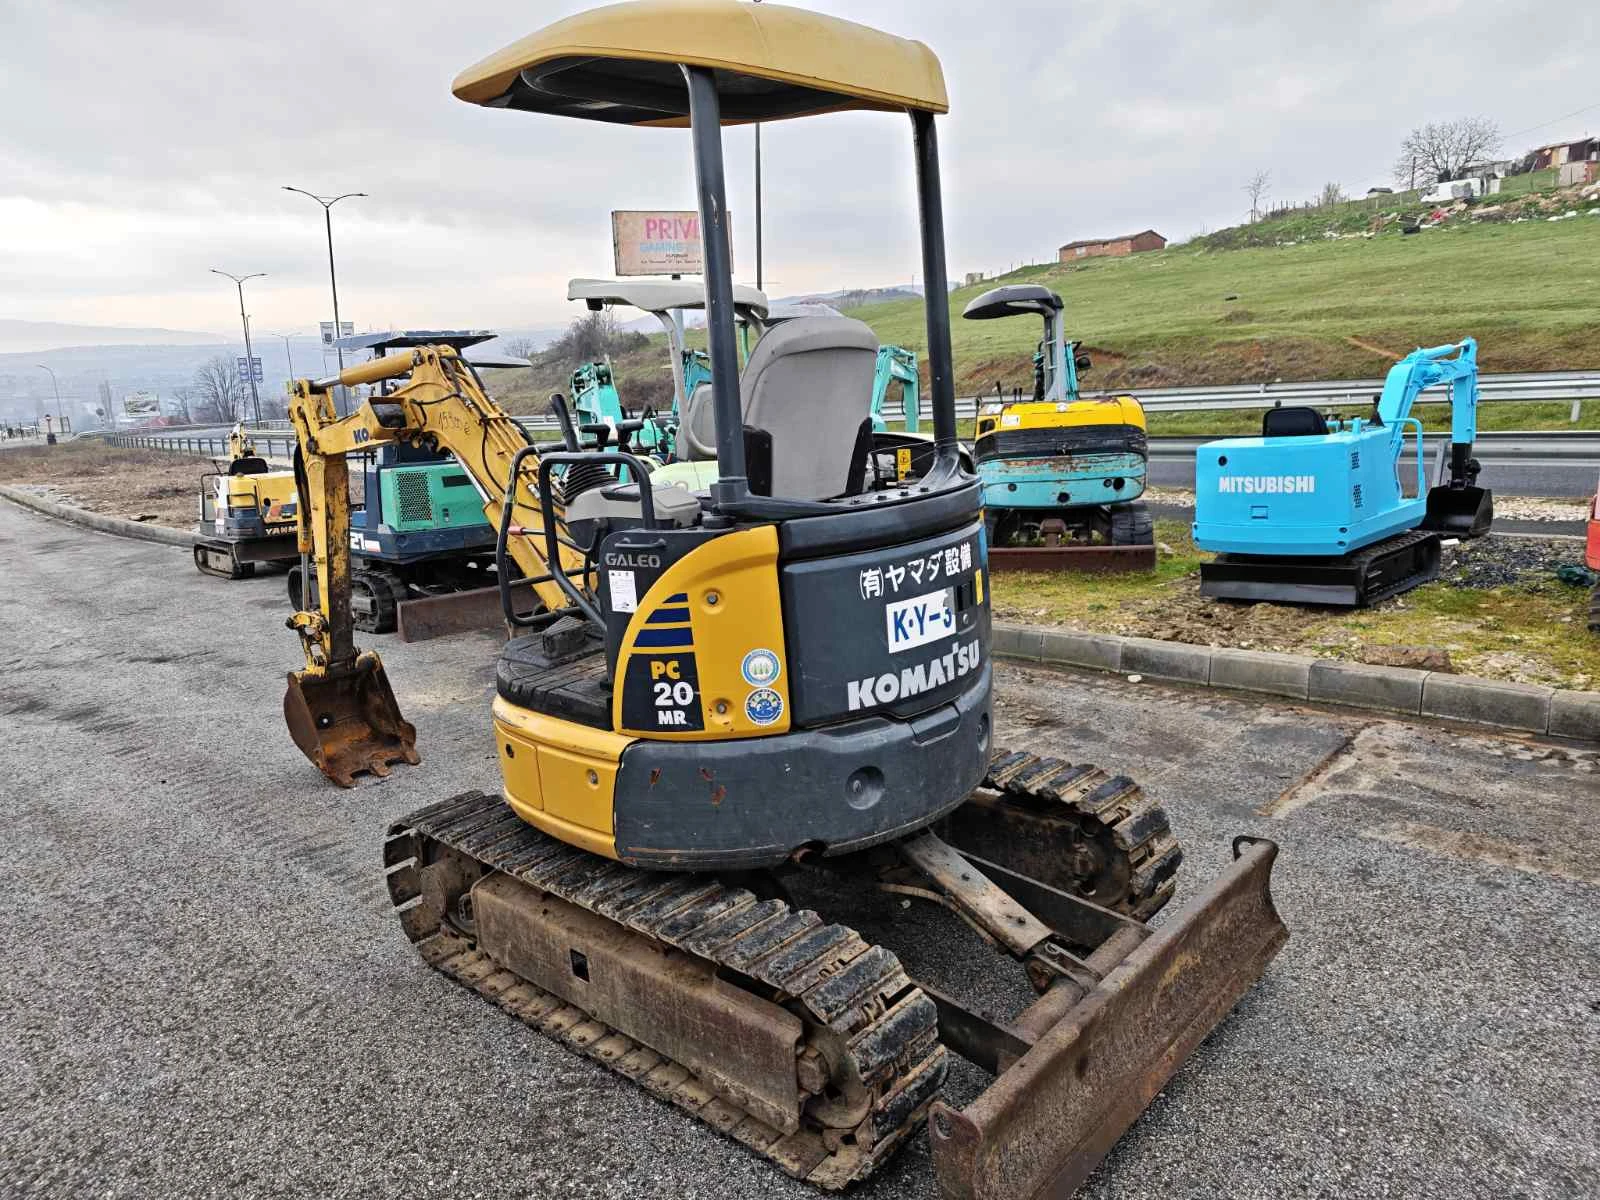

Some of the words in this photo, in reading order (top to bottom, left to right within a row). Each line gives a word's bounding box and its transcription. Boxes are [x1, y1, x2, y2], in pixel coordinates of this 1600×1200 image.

[645, 218, 698, 240] PRIV
[1218, 475, 1315, 494] MITSUBISHI
[604, 552, 661, 568] GALEO
[650, 660, 680, 680] PC
[847, 638, 980, 712] KOMATSU
[652, 682, 694, 707] 20
[657, 709, 687, 725] MR
